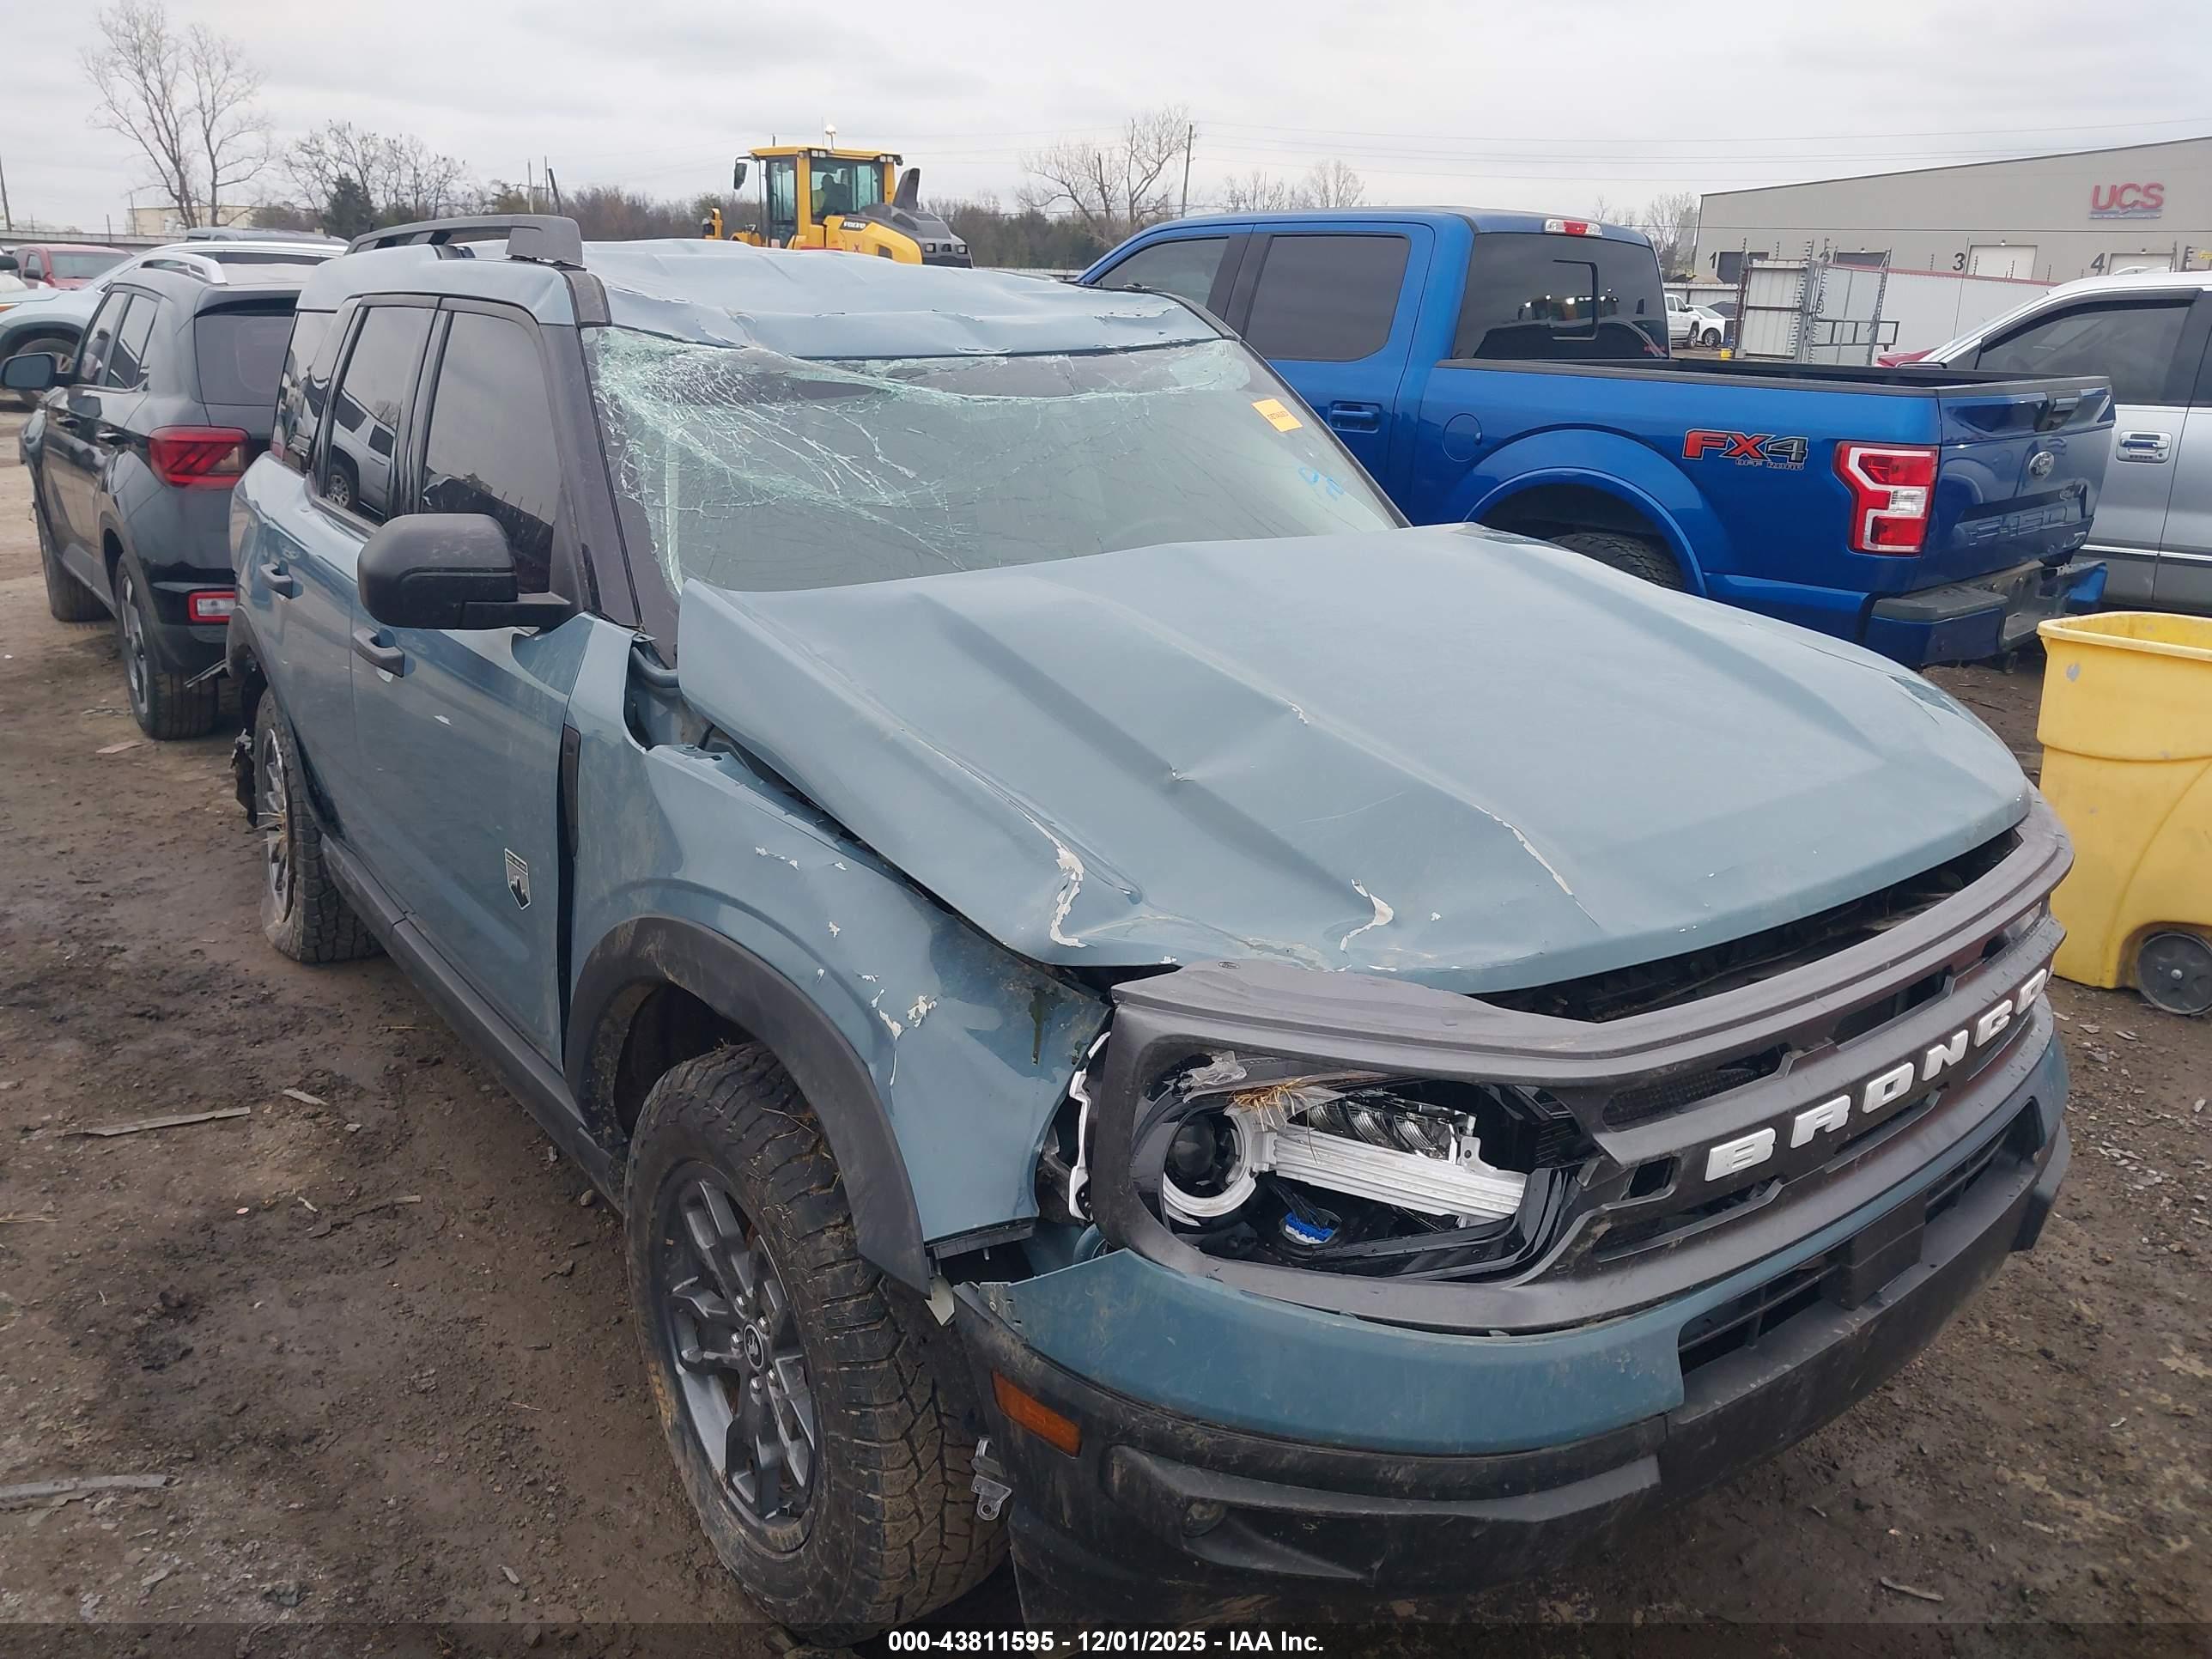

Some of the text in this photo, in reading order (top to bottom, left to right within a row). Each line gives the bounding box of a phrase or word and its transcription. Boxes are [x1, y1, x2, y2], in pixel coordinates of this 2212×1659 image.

[2092, 182, 2165, 210] UCS
[1709, 252, 1717, 269] 1
[1952, 252, 1966, 271] 3
[2090, 252, 2106, 272] 4
[1682, 428, 1808, 464] FX4
[1704, 968, 2048, 1182] BRONCO
